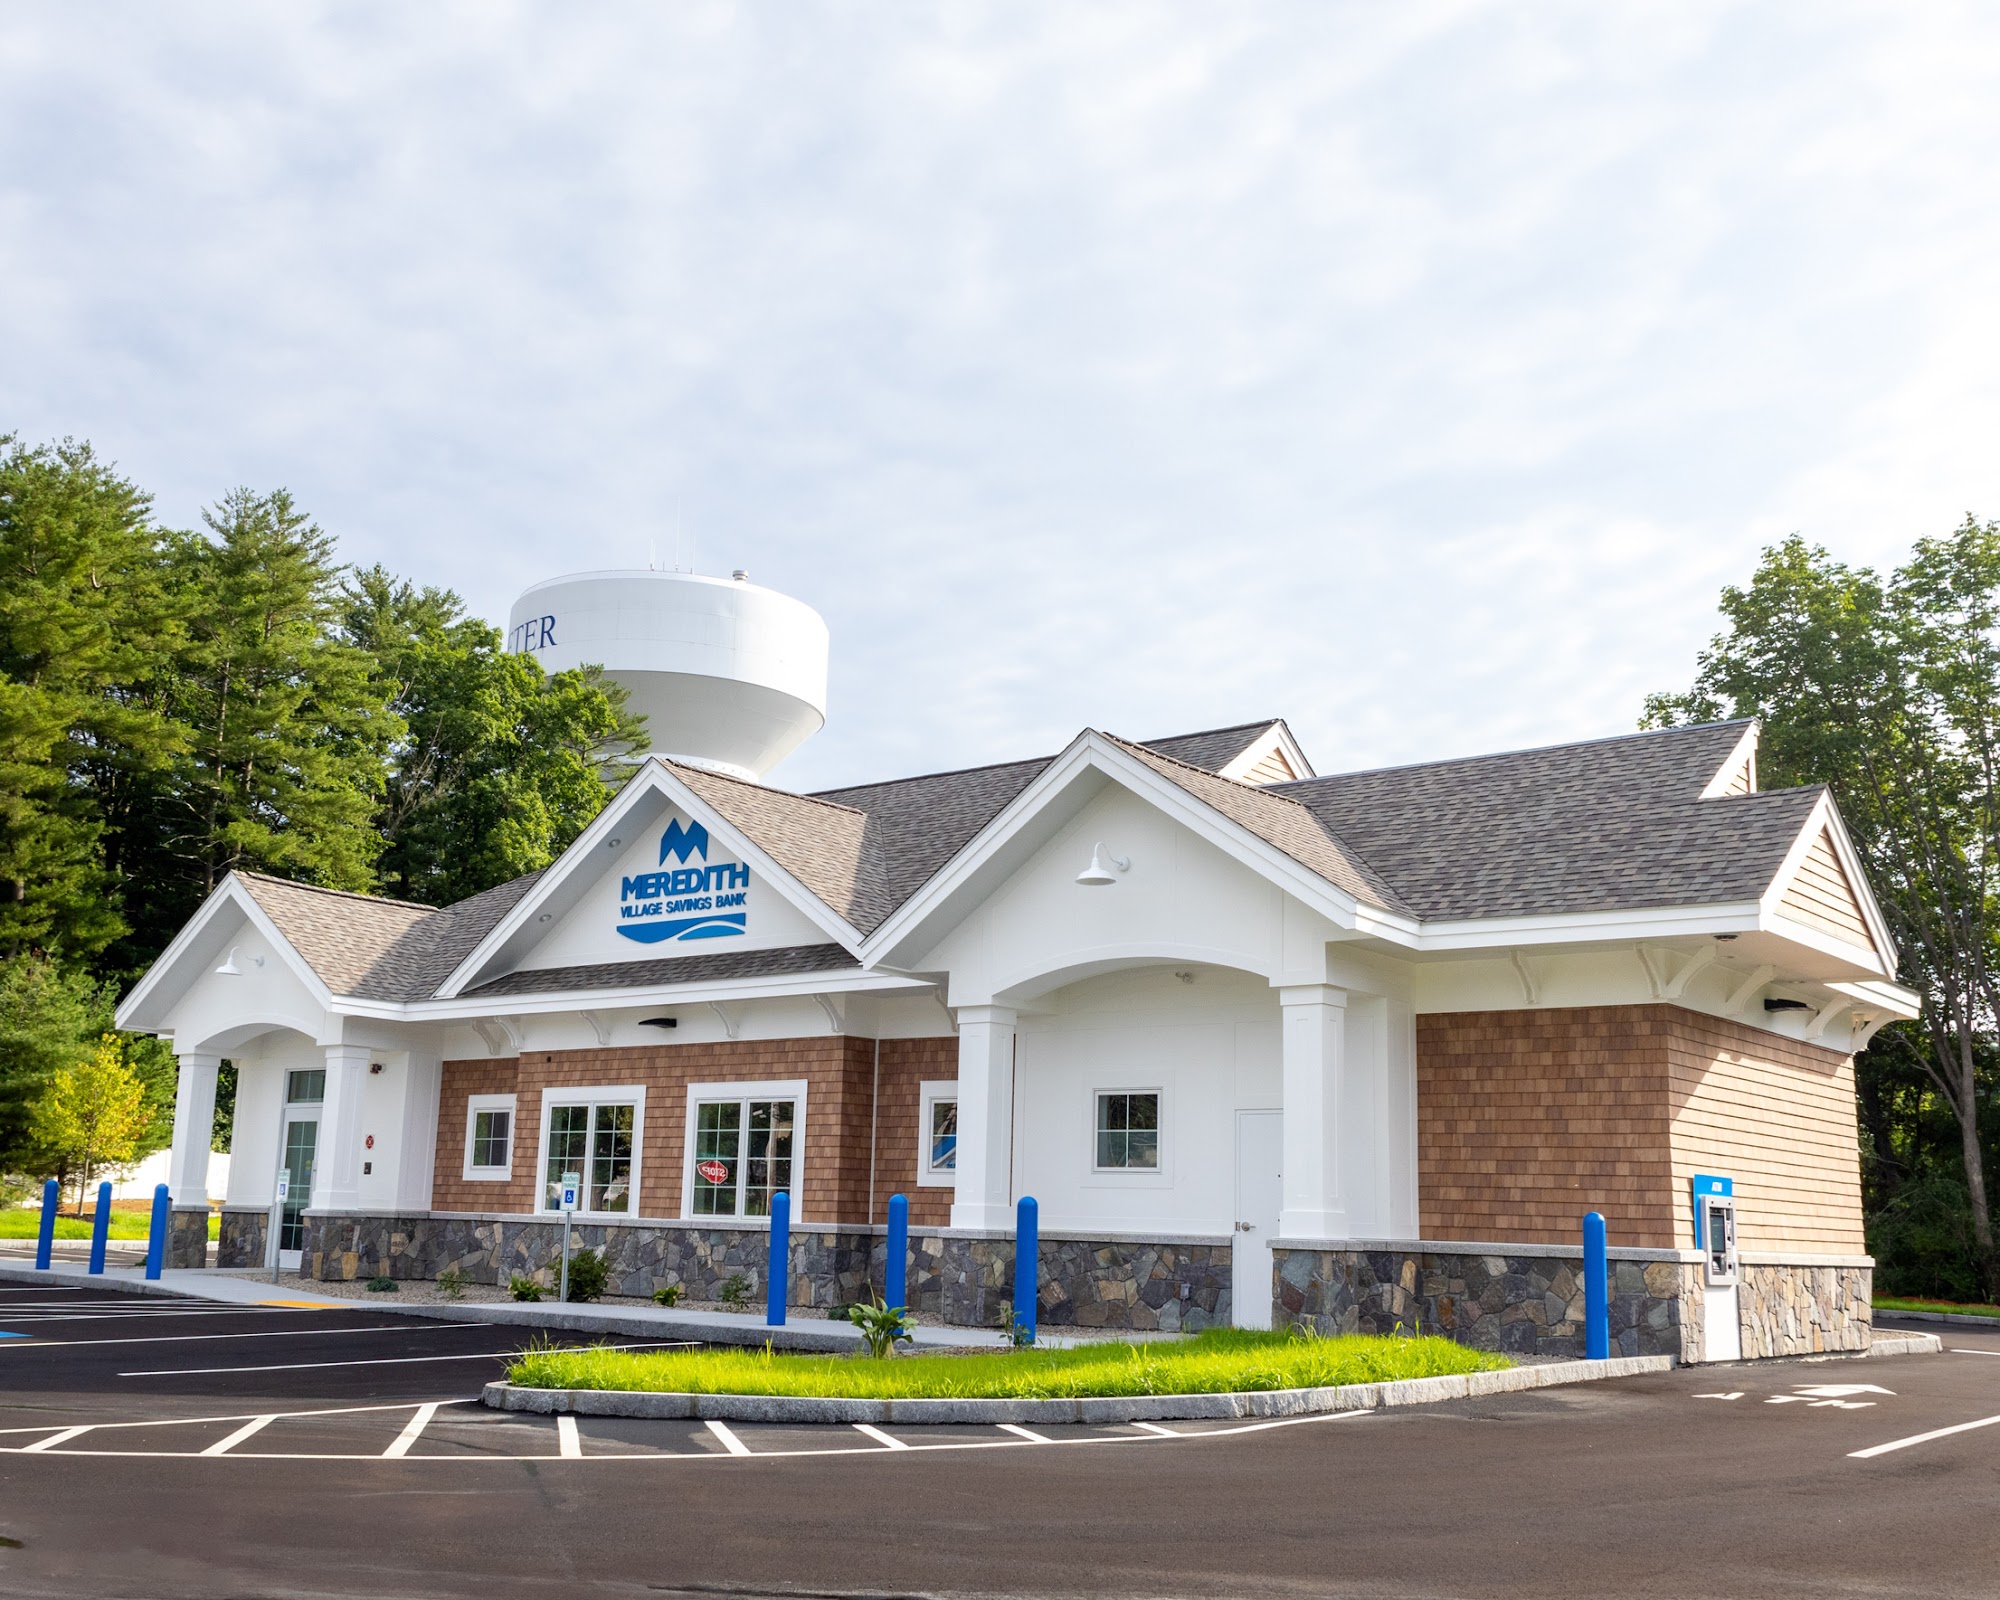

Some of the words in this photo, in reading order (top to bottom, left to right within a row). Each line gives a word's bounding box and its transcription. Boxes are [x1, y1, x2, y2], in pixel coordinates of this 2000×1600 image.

[621, 862, 750, 902] MEREDITH
[620, 902, 663, 919] VILLAGE
[666, 897, 712, 914] SAVINGS
[715, 892, 747, 908] BANK
